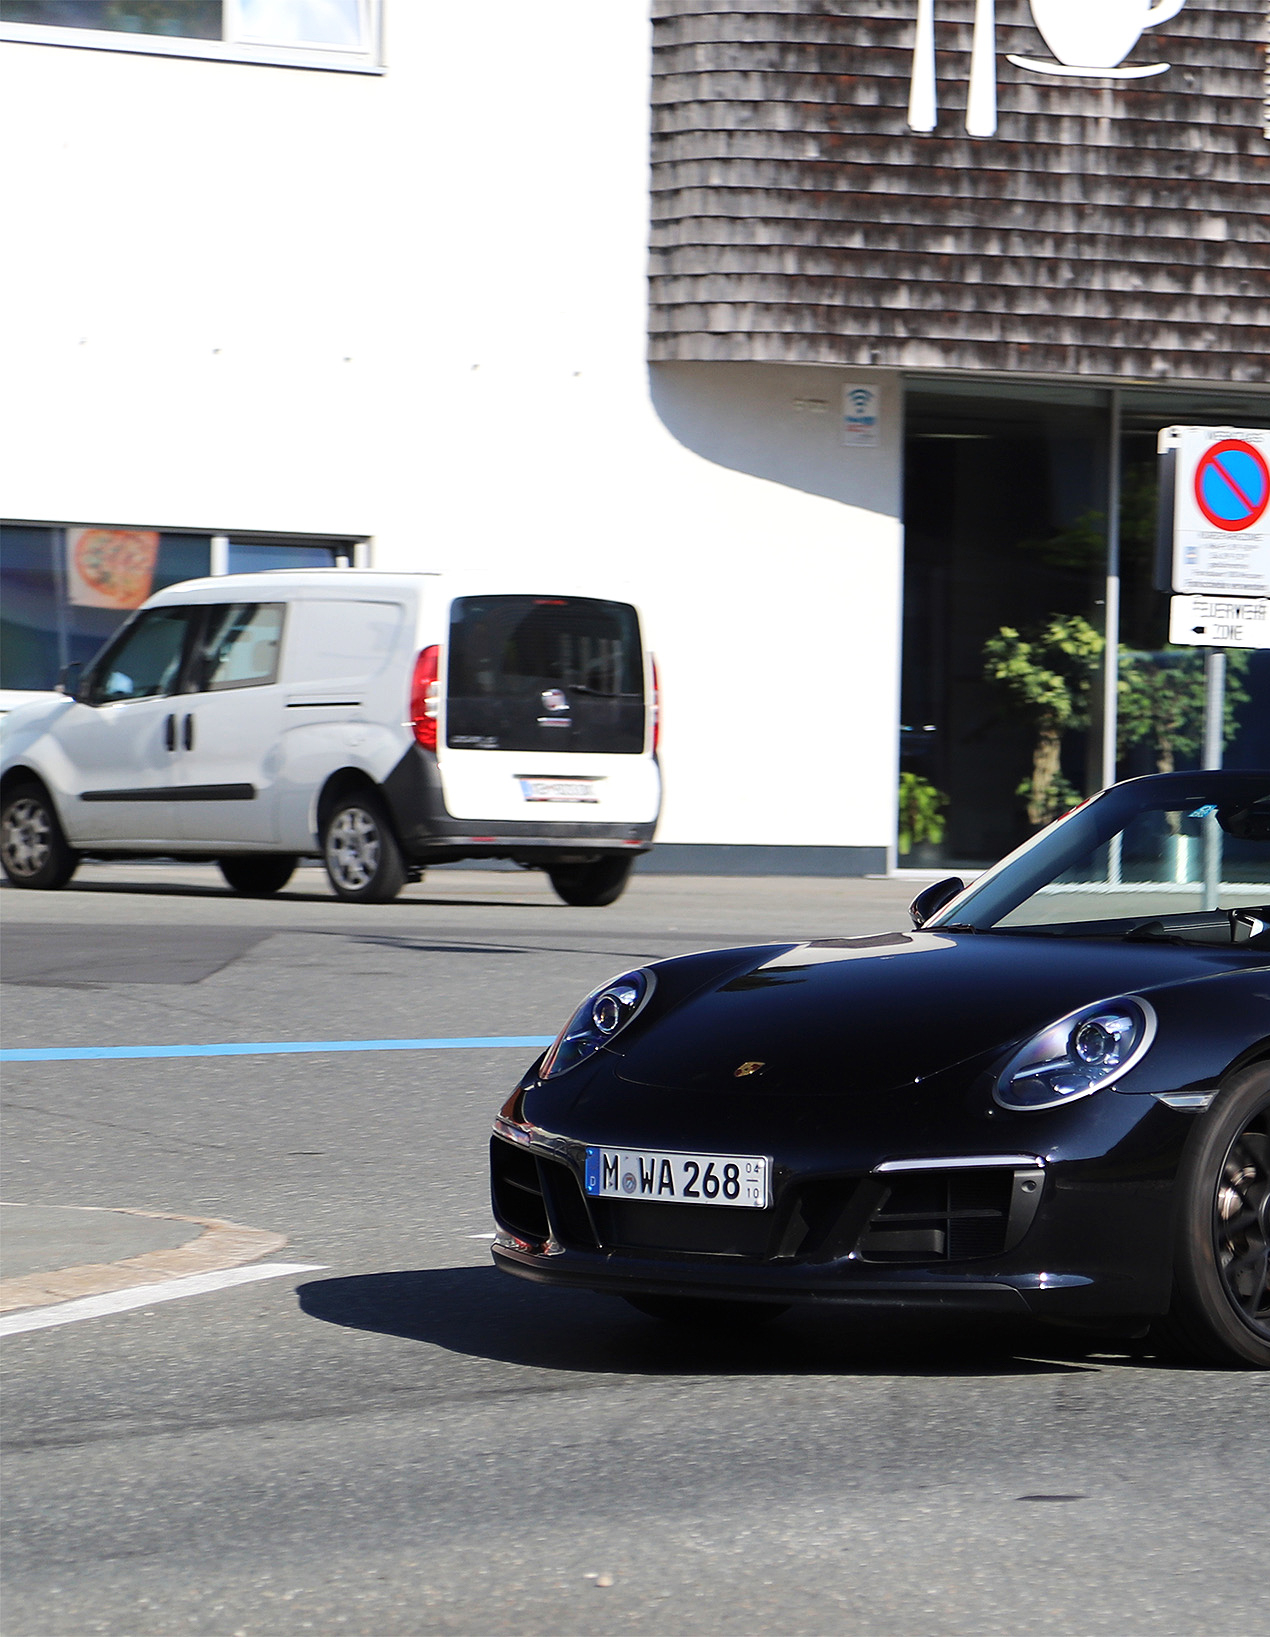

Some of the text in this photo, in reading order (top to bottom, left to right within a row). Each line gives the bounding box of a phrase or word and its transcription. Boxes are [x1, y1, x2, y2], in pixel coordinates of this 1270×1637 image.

[602, 1153, 741, 1200] M WA 268
